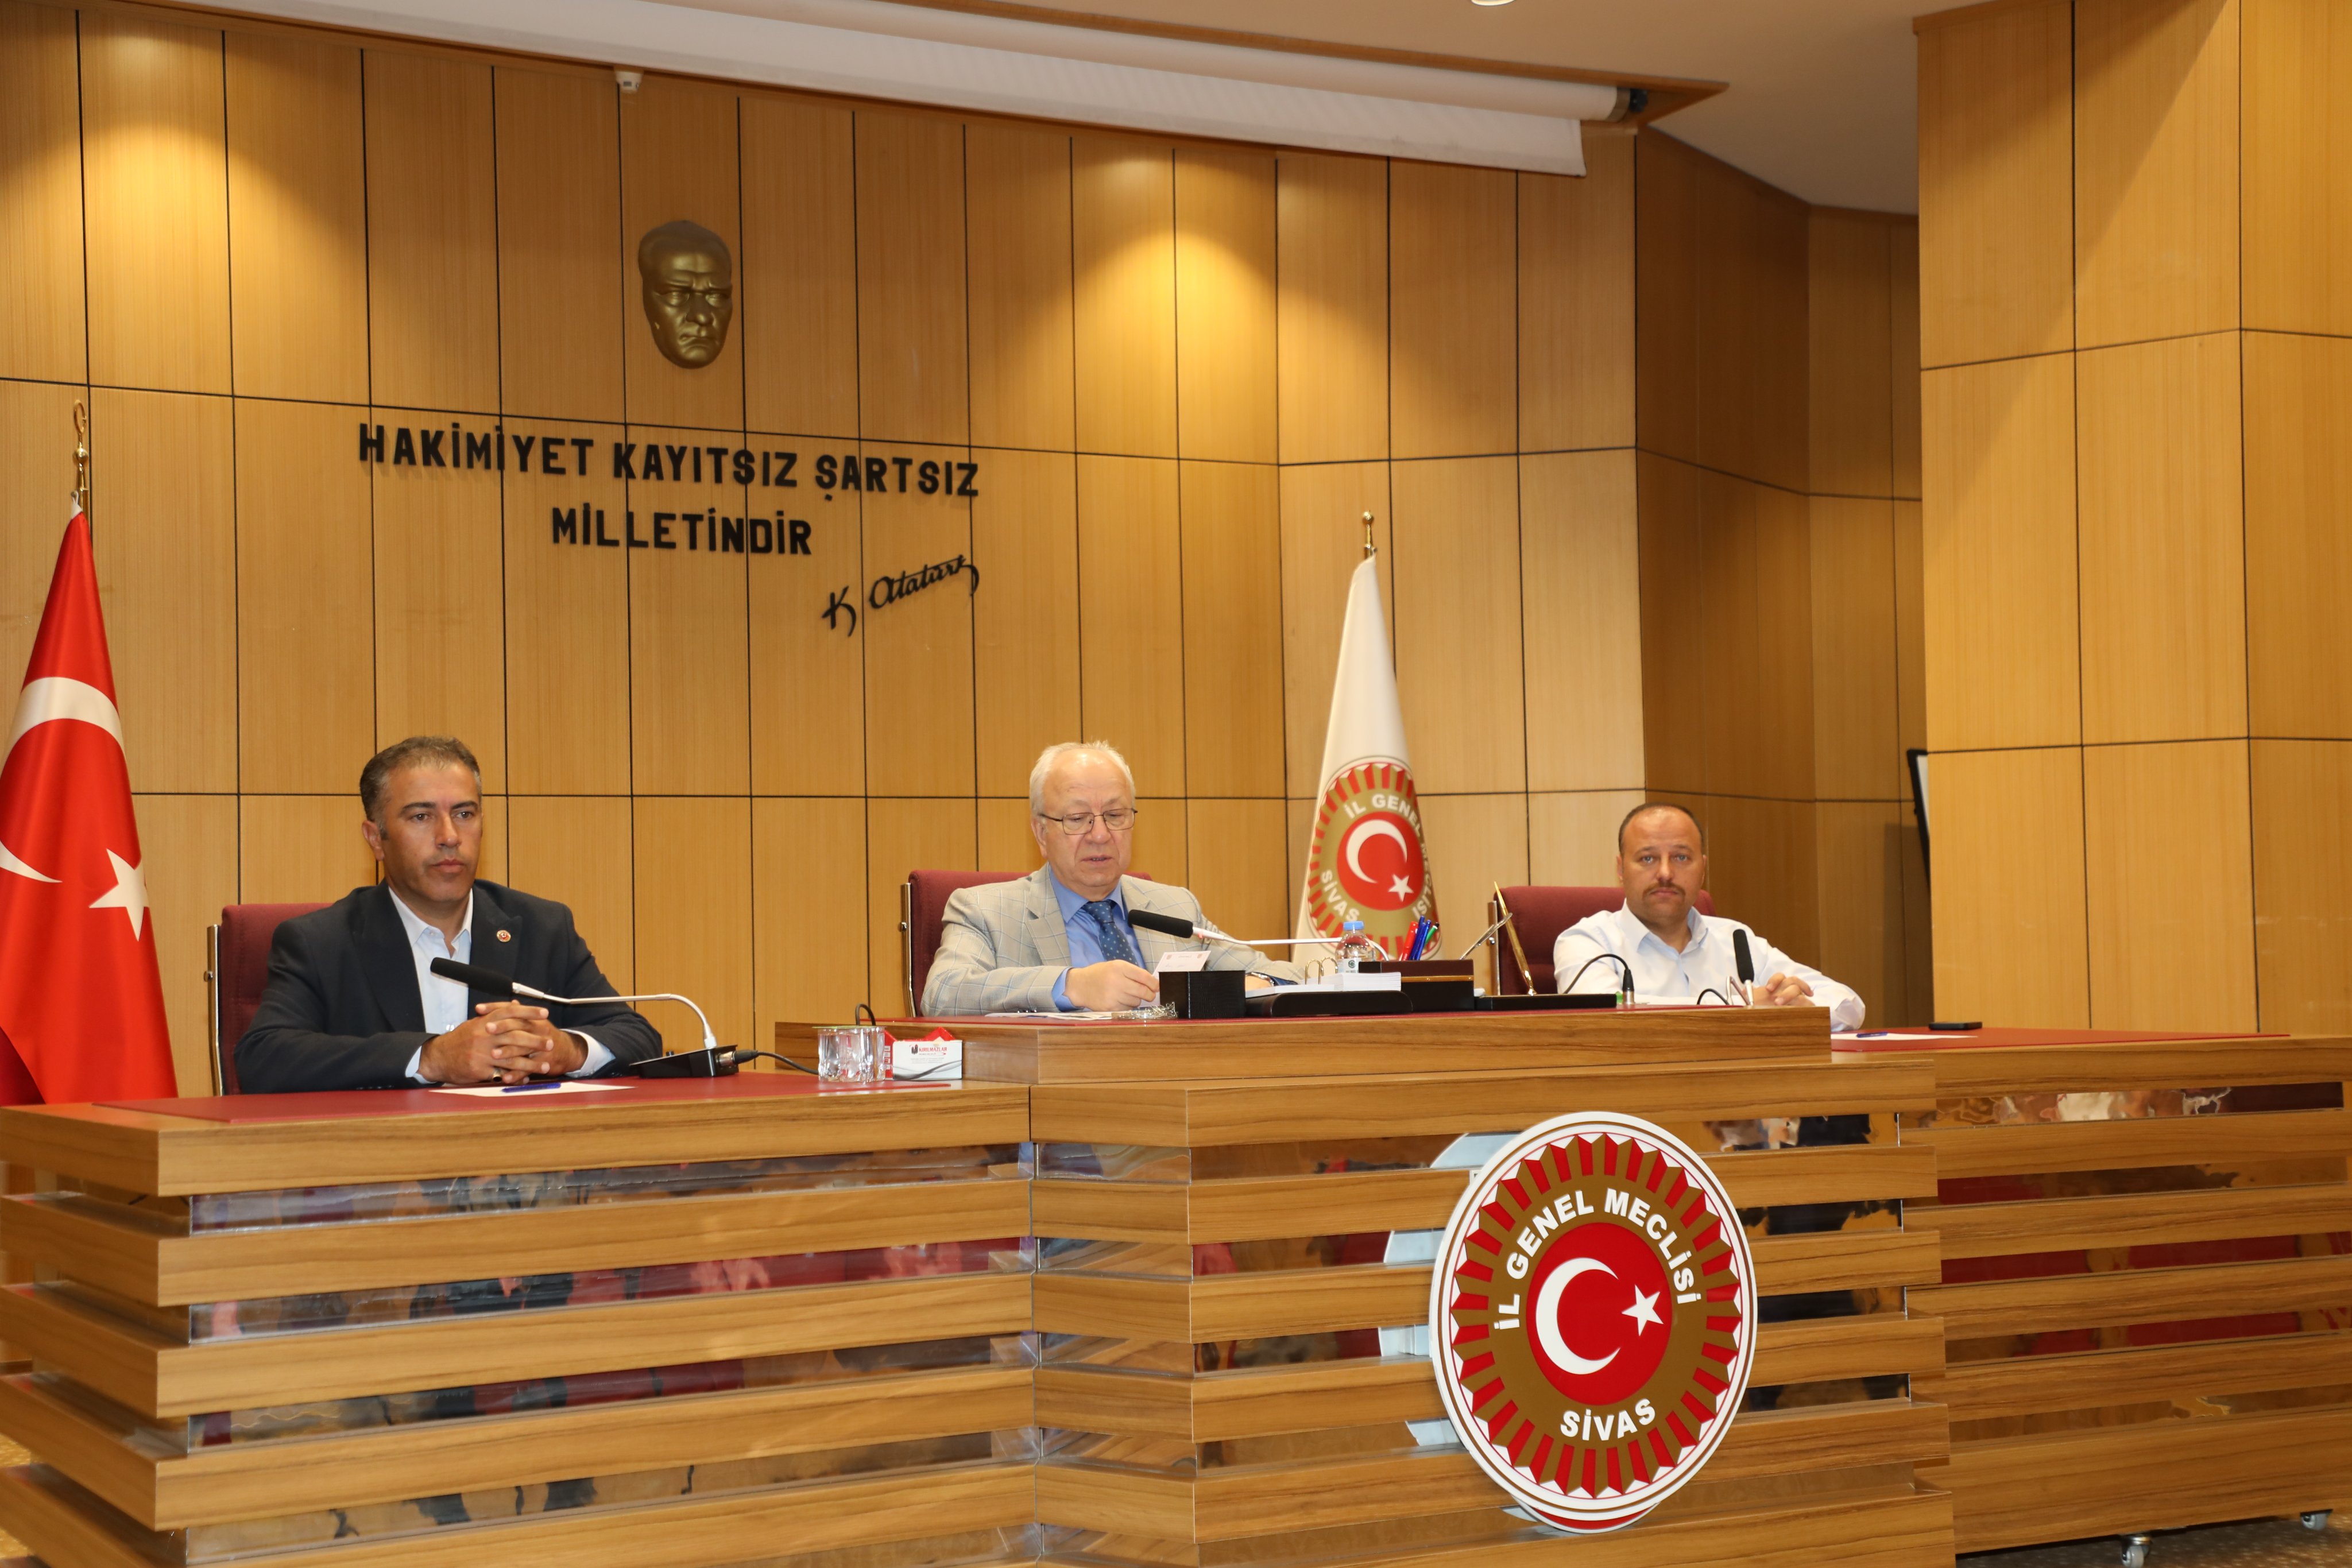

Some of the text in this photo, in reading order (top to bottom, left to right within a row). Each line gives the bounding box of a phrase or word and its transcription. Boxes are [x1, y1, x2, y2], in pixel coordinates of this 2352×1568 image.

[359, 422, 978, 502] HAKİMİYET KAYITSIZ ŞARTSIZ
[552, 502, 811, 555] MİLLETİNDİR
[1344, 801, 1367, 819] İL
[1372, 793, 1421, 837] GENEL
[1322, 869, 1360, 922] SİVAS
[1494, 1187, 1702, 1330] İL GENEL MECLİSİ
[1560, 1398, 1656, 1441] SİVAS
